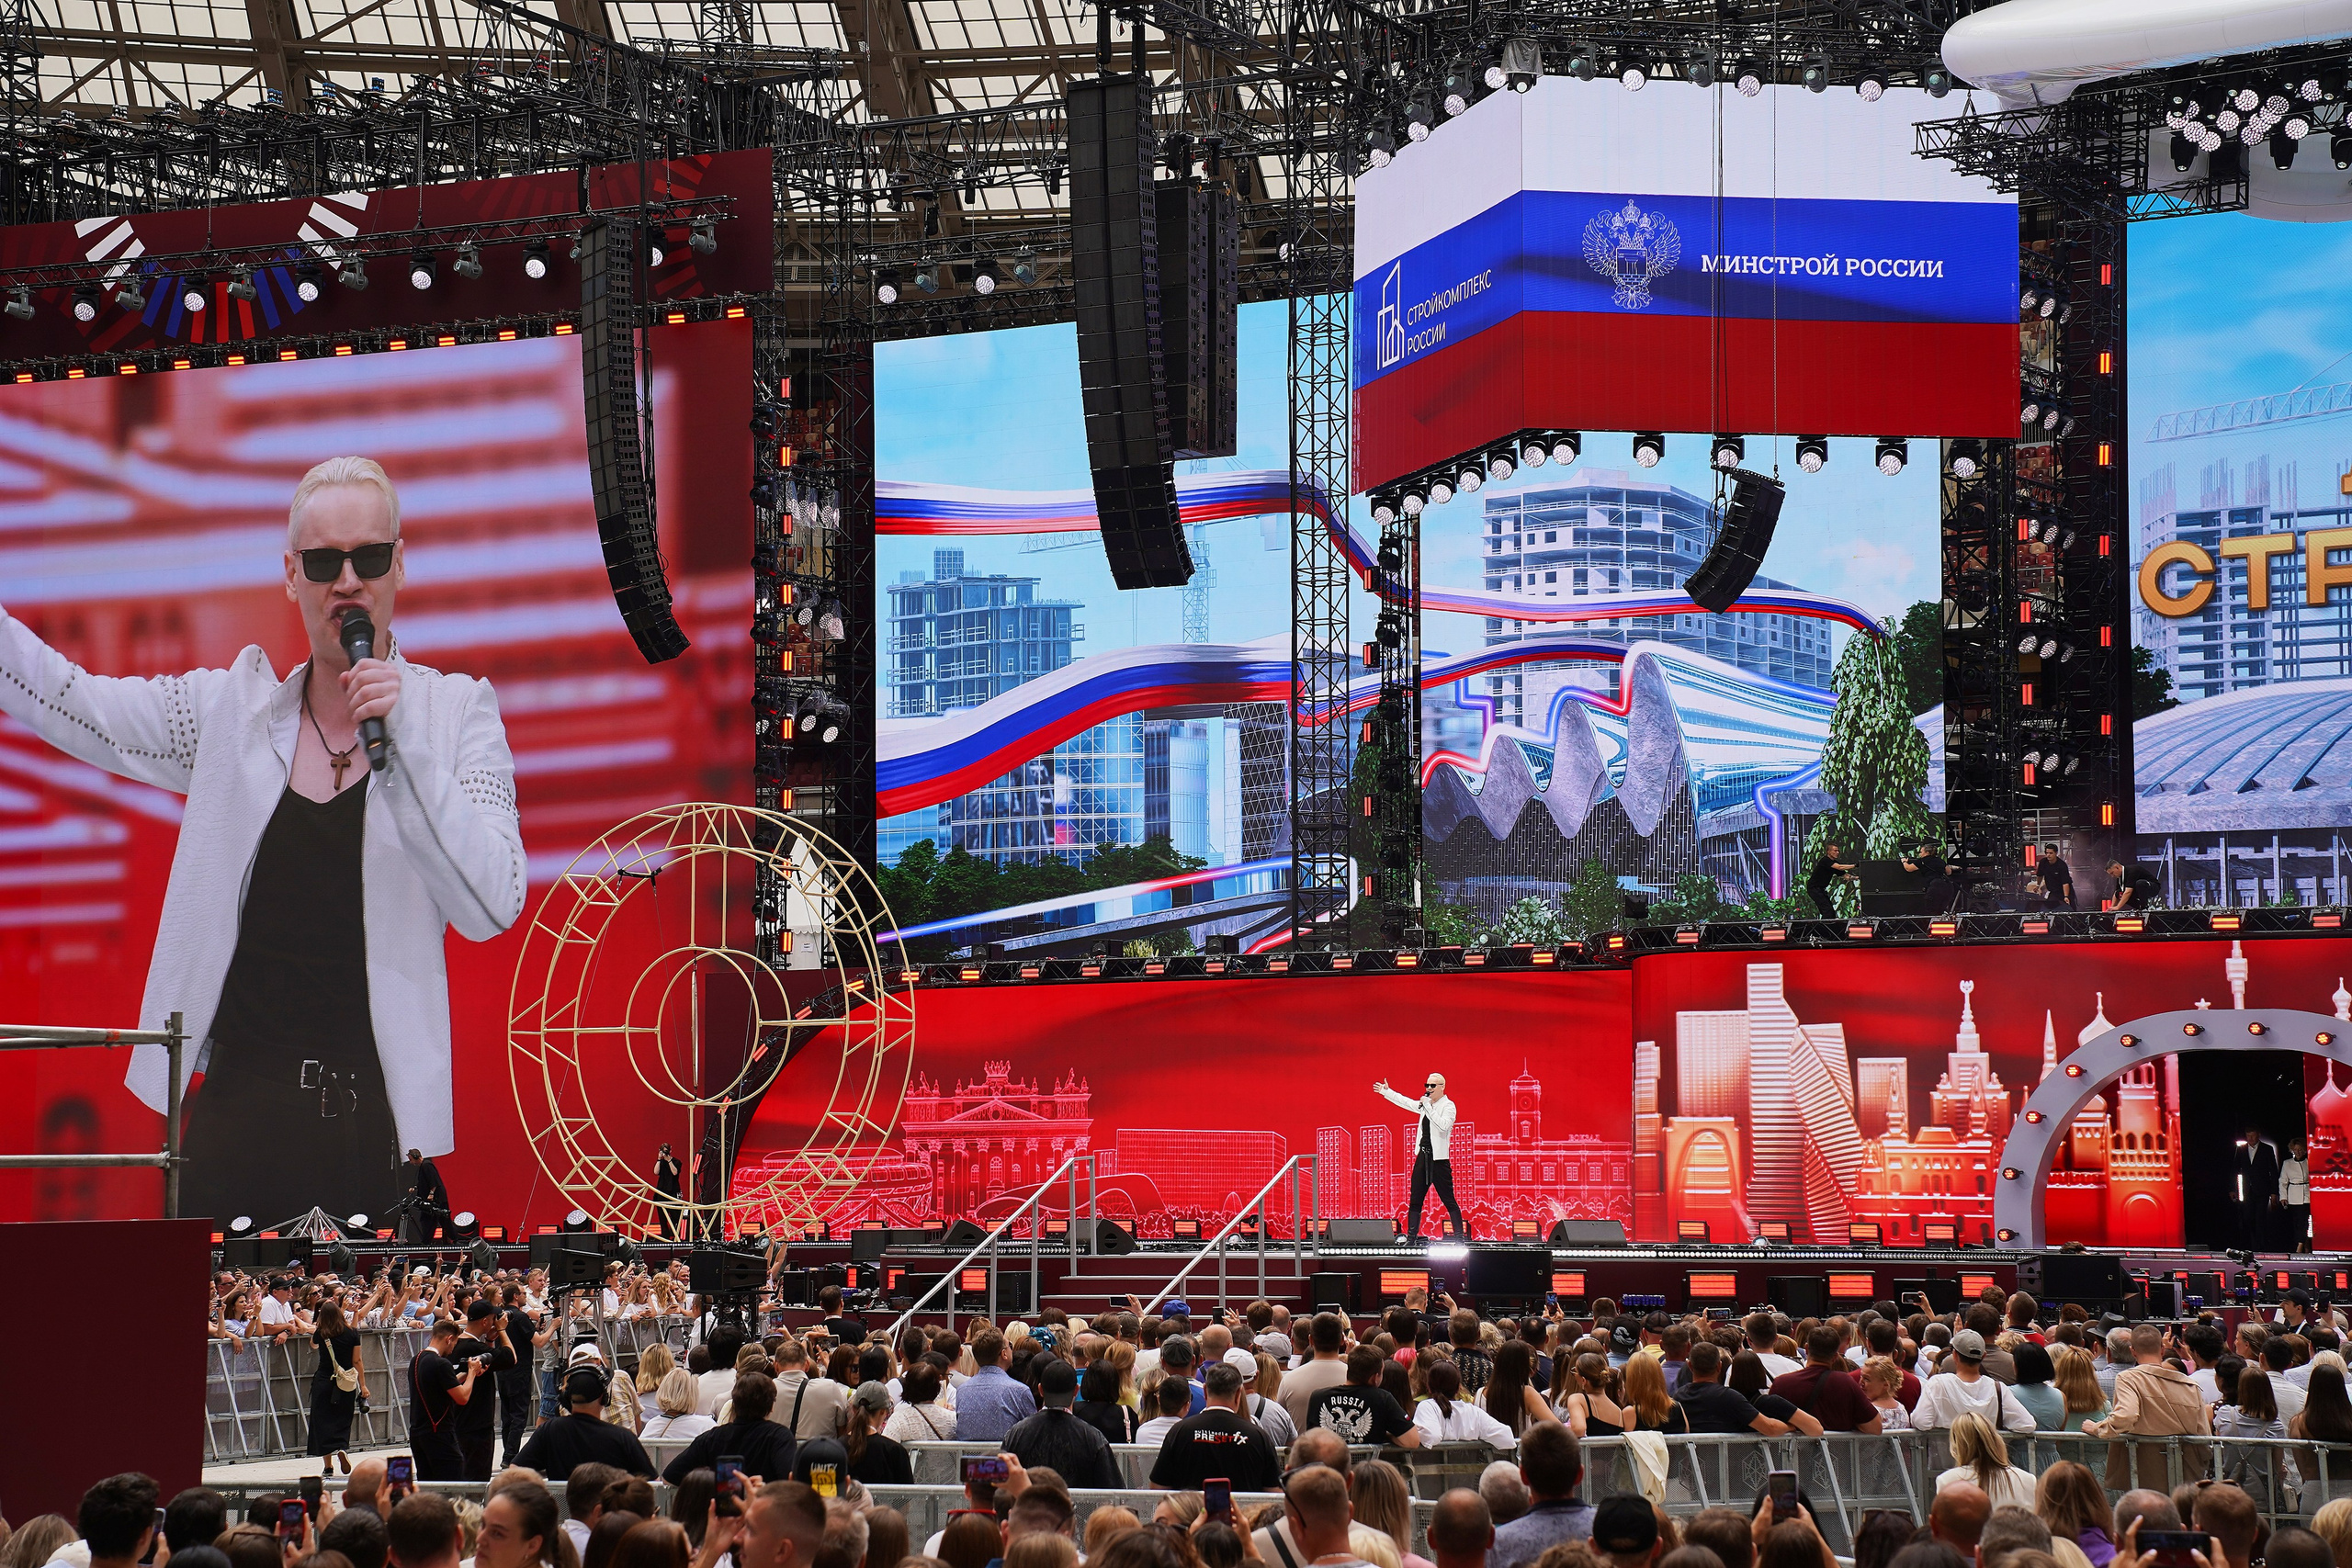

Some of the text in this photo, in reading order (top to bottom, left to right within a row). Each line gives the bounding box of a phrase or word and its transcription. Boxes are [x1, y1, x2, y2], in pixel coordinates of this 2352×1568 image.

[1701, 254, 1944, 278] МИНСТРОЙ РОССИИ
[1407, 268, 1492, 326] СТРОЙКОМПЛЕКС
[1408, 321, 1446, 356] РОССИИ
[1330, 1395, 1364, 1409] RUSSIA
[810, 1461, 838, 1473] UNITY
